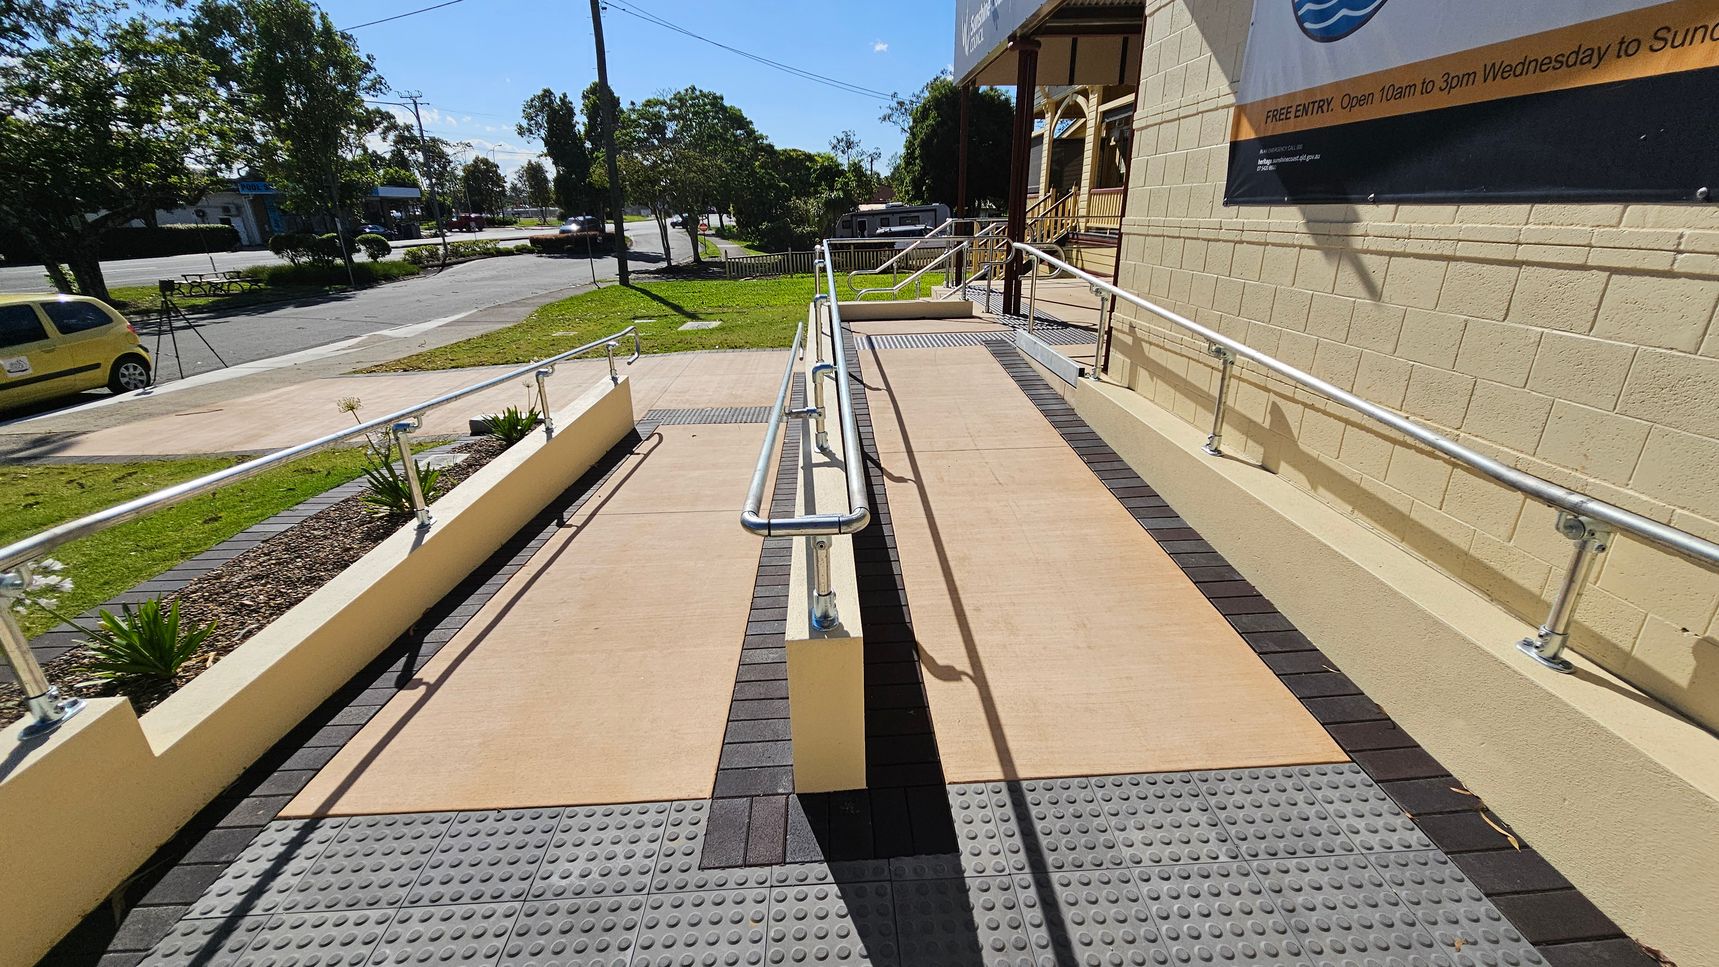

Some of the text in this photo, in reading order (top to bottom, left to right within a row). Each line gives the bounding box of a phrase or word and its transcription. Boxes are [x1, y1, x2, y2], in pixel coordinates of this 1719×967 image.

[1265, 104, 1292, 125] FREE
[1293, 96, 1334, 119] ENTRY.
[1340, 92, 1374, 112] Open
[1379, 82, 1417, 103] 10am
[1420, 78, 1435, 95] to
[1439, 70, 1477, 95] 3pm
[1483, 43, 1611, 82] Wednesday
[1616, 36, 1642, 59] to
[240, 183, 261, 191] POOL
